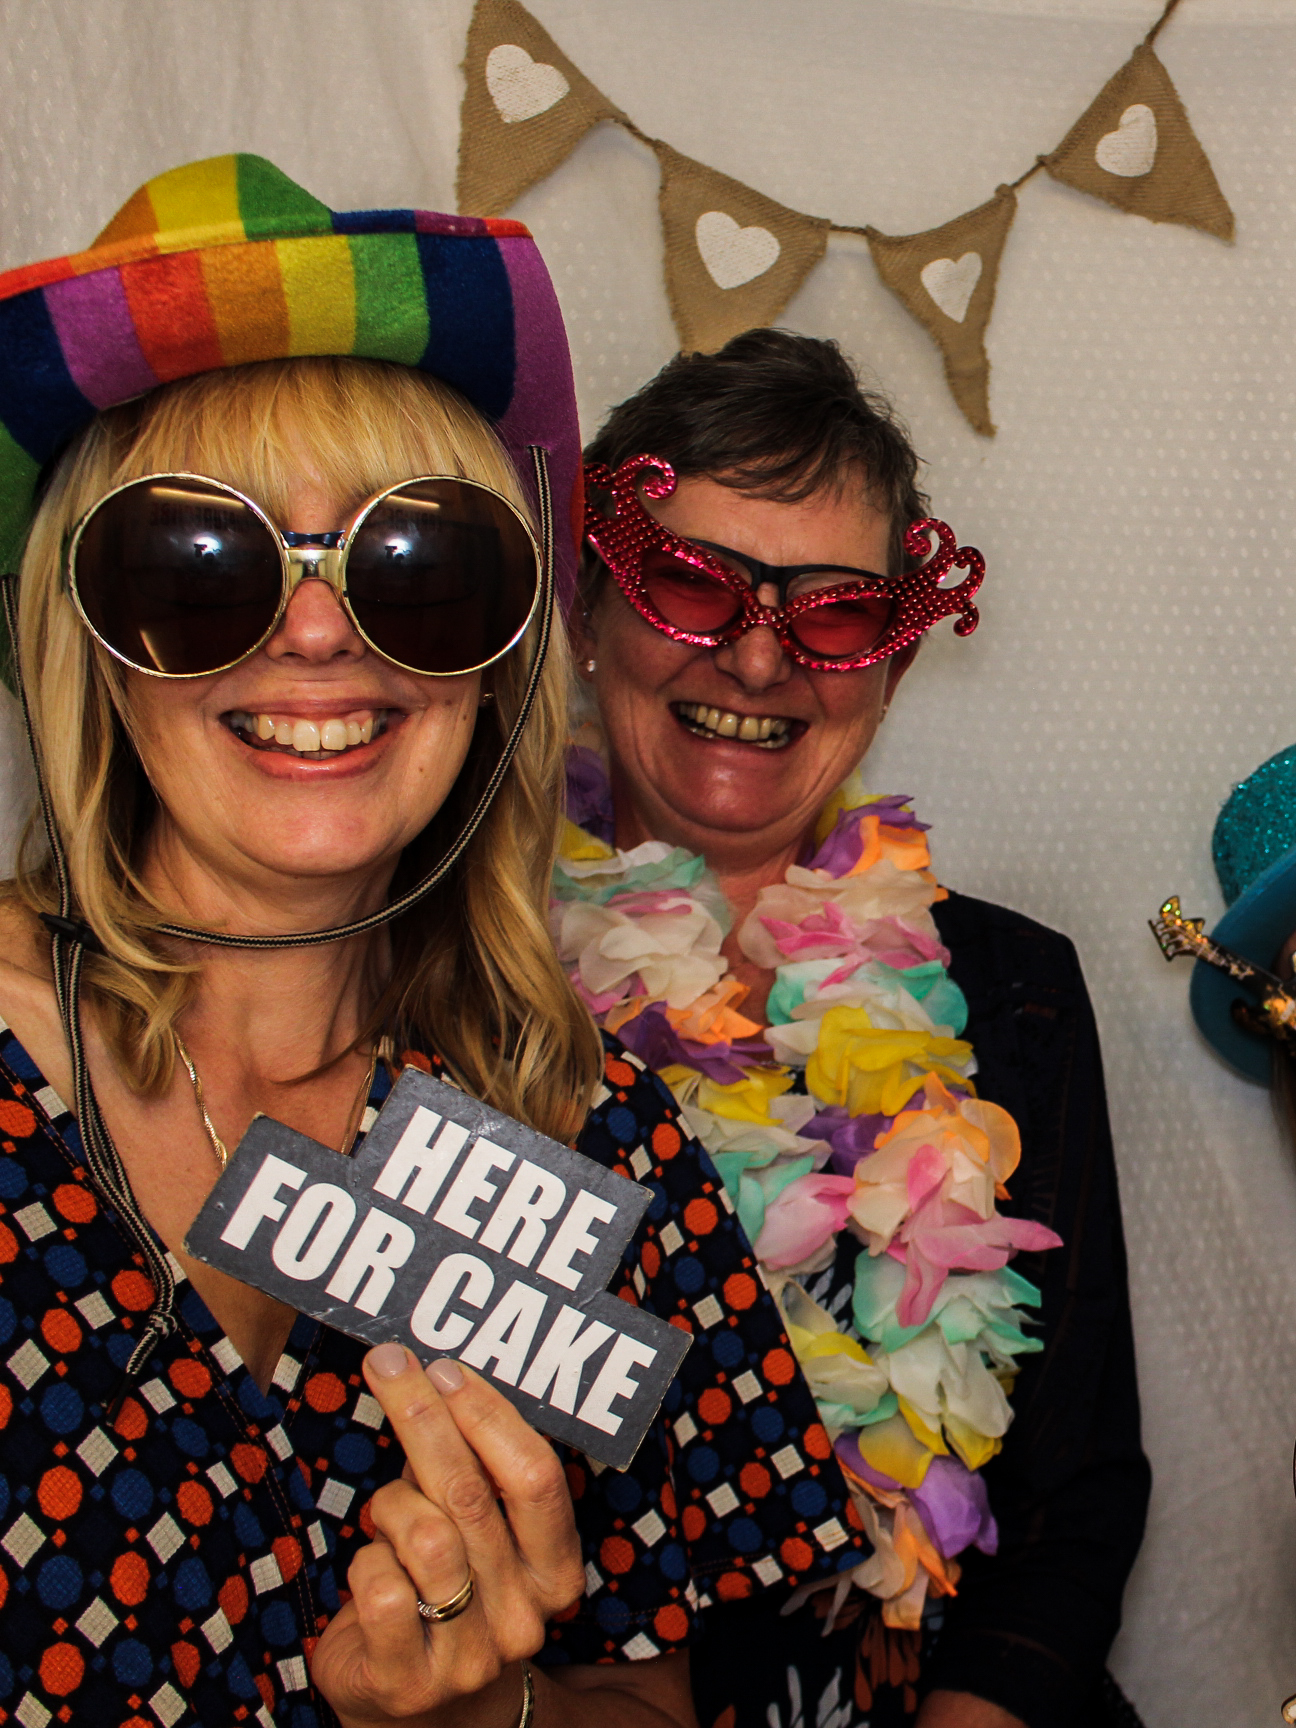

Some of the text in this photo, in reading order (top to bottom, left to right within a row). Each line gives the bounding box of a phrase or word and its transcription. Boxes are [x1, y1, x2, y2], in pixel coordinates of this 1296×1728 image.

[219, 1153, 658, 1437] FOR CAKE
[372, 1104, 618, 1291] HERE
